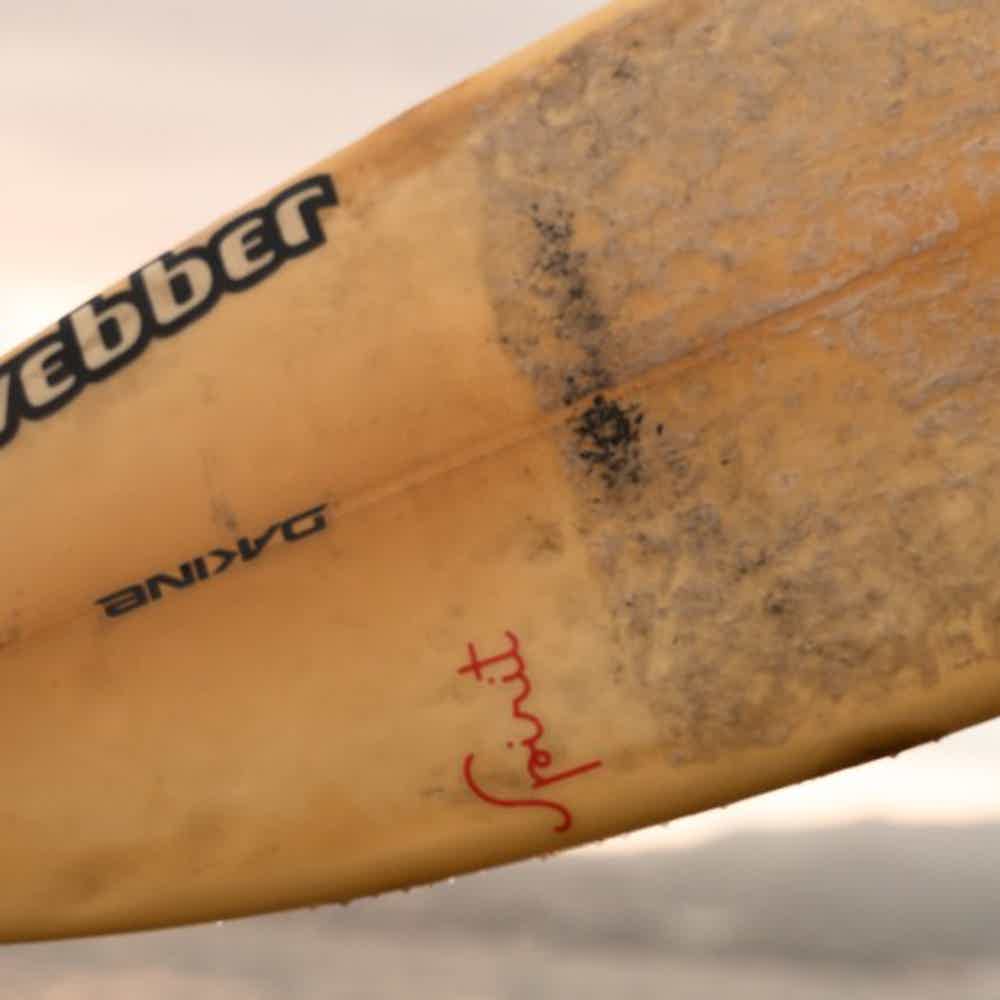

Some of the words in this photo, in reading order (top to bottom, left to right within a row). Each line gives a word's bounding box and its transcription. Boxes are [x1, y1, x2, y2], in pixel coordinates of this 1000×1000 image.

[0, 173, 340, 448] ebber
[94, 503, 328, 618] DAKINE
[457, 629, 603, 833] Spirit
